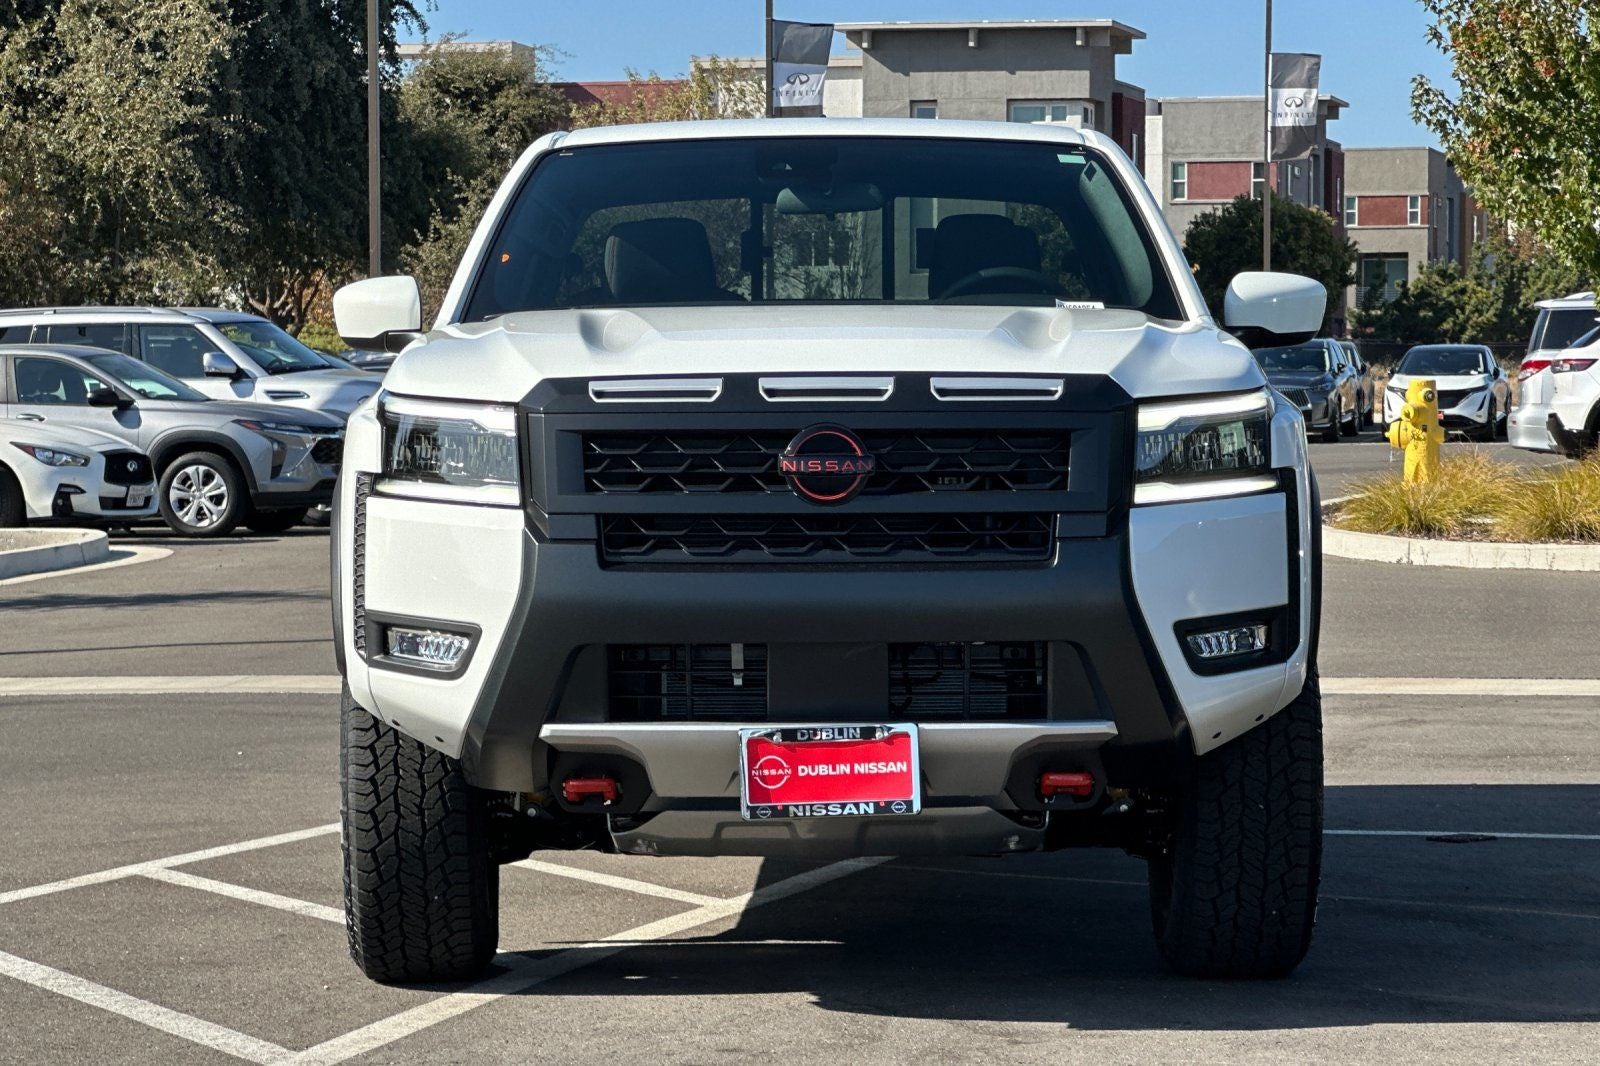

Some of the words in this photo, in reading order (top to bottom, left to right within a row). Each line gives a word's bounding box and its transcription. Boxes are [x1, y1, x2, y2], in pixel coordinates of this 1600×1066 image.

[782, 460, 873, 472] NISSAN
[797, 727, 861, 741] DUBLIN
[798, 763, 851, 777] DUBLIN
[854, 761, 907, 774] NISSAN
[789, 802, 875, 817] NISSAN
